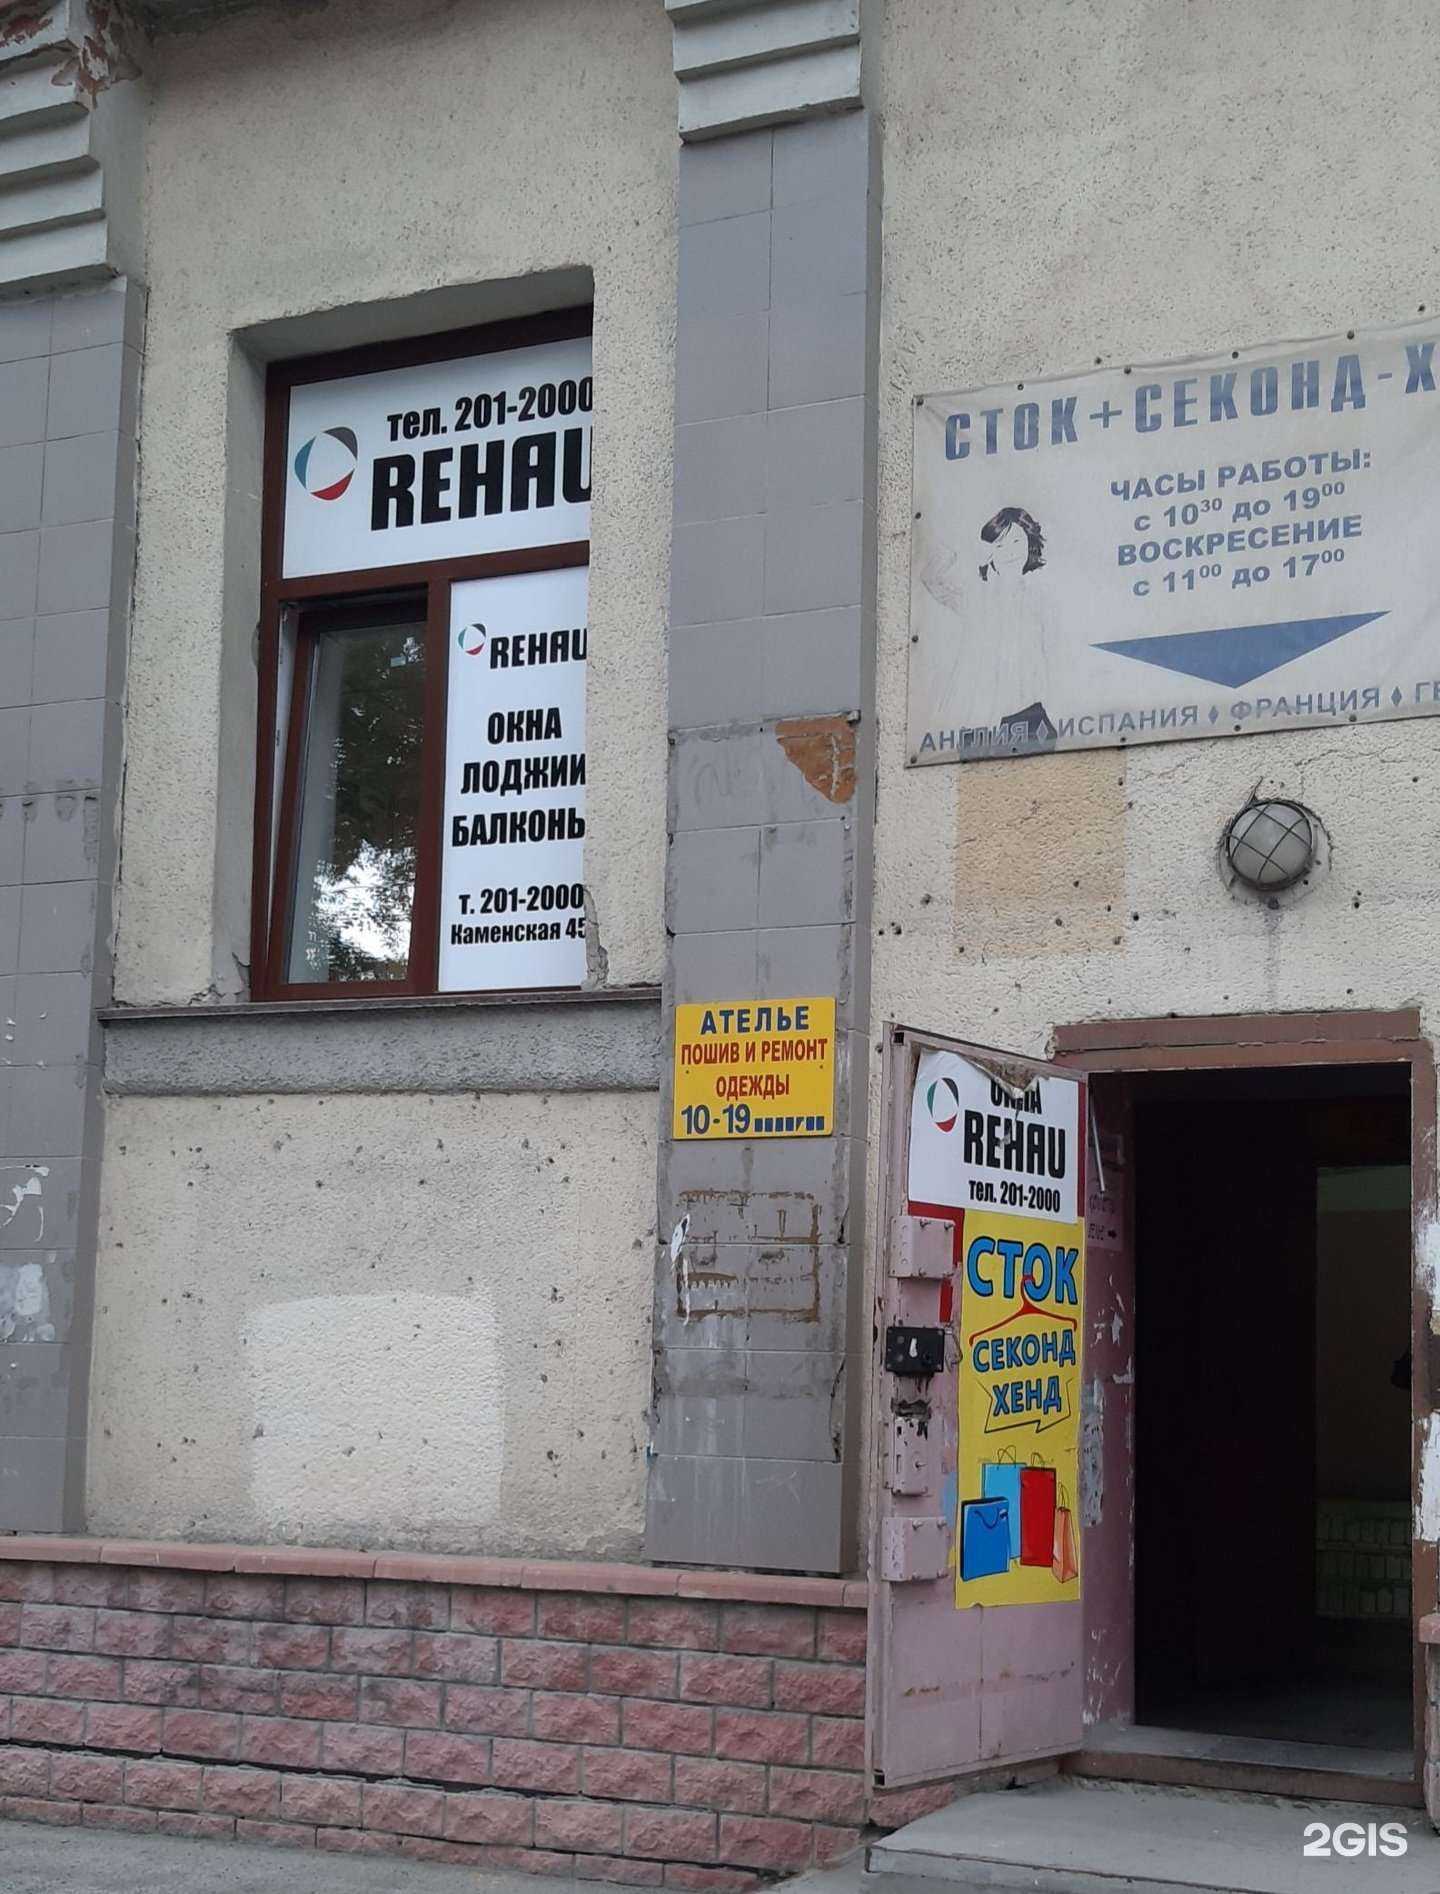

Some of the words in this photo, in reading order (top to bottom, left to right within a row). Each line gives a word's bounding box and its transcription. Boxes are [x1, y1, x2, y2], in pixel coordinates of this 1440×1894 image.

[387, 407, 448, 442] тел.
[455, 376, 593, 432] 201-2000
[371, 425, 593, 531] REHAU
[1110, 470, 1206, 501] ЧАСЫ
[1217, 448, 1371, 488] РАБОТЫ:
[1232, 499, 1271, 524] до
[1117, 515, 1363, 567] ВОСКРЕСЕНИЕ
[1231, 565, 1270, 589] до
[490, 628, 587, 669] REHAU
[487, 707, 562, 745] ОКНА
[919, 720, 1029, 753] АНГЛИЯ
[1058, 704, 1199, 738] ИСПАНИЯ
[1230, 687, 1380, 721] ФРАНЦИЯ
[460, 753, 587, 797] ЛОДЖИИ
[458, 894, 475, 915] т.
[480, 883, 585, 914] 201-2000
[451, 922, 561, 945] Каменская
[700, 1005, 810, 1035] АТЕЛЬЕ
[681, 1041, 740, 1065] ПОШИВ
[745, 1040, 755, 1063] И
[761, 1038, 828, 1062] РЕМОНТ
[716, 1074, 790, 1101] ОДЕЖДЫ
[963, 1109, 1067, 1179] REHAU
[968, 1180, 997, 1204] тел.
[1000, 1181, 1061, 1213] 201-2000
[966, 1236, 1079, 1305] СТОК
[972, 1329, 1076, 1373] СЕКОНД
[992, 1376, 1062, 1416] ХЕНД
